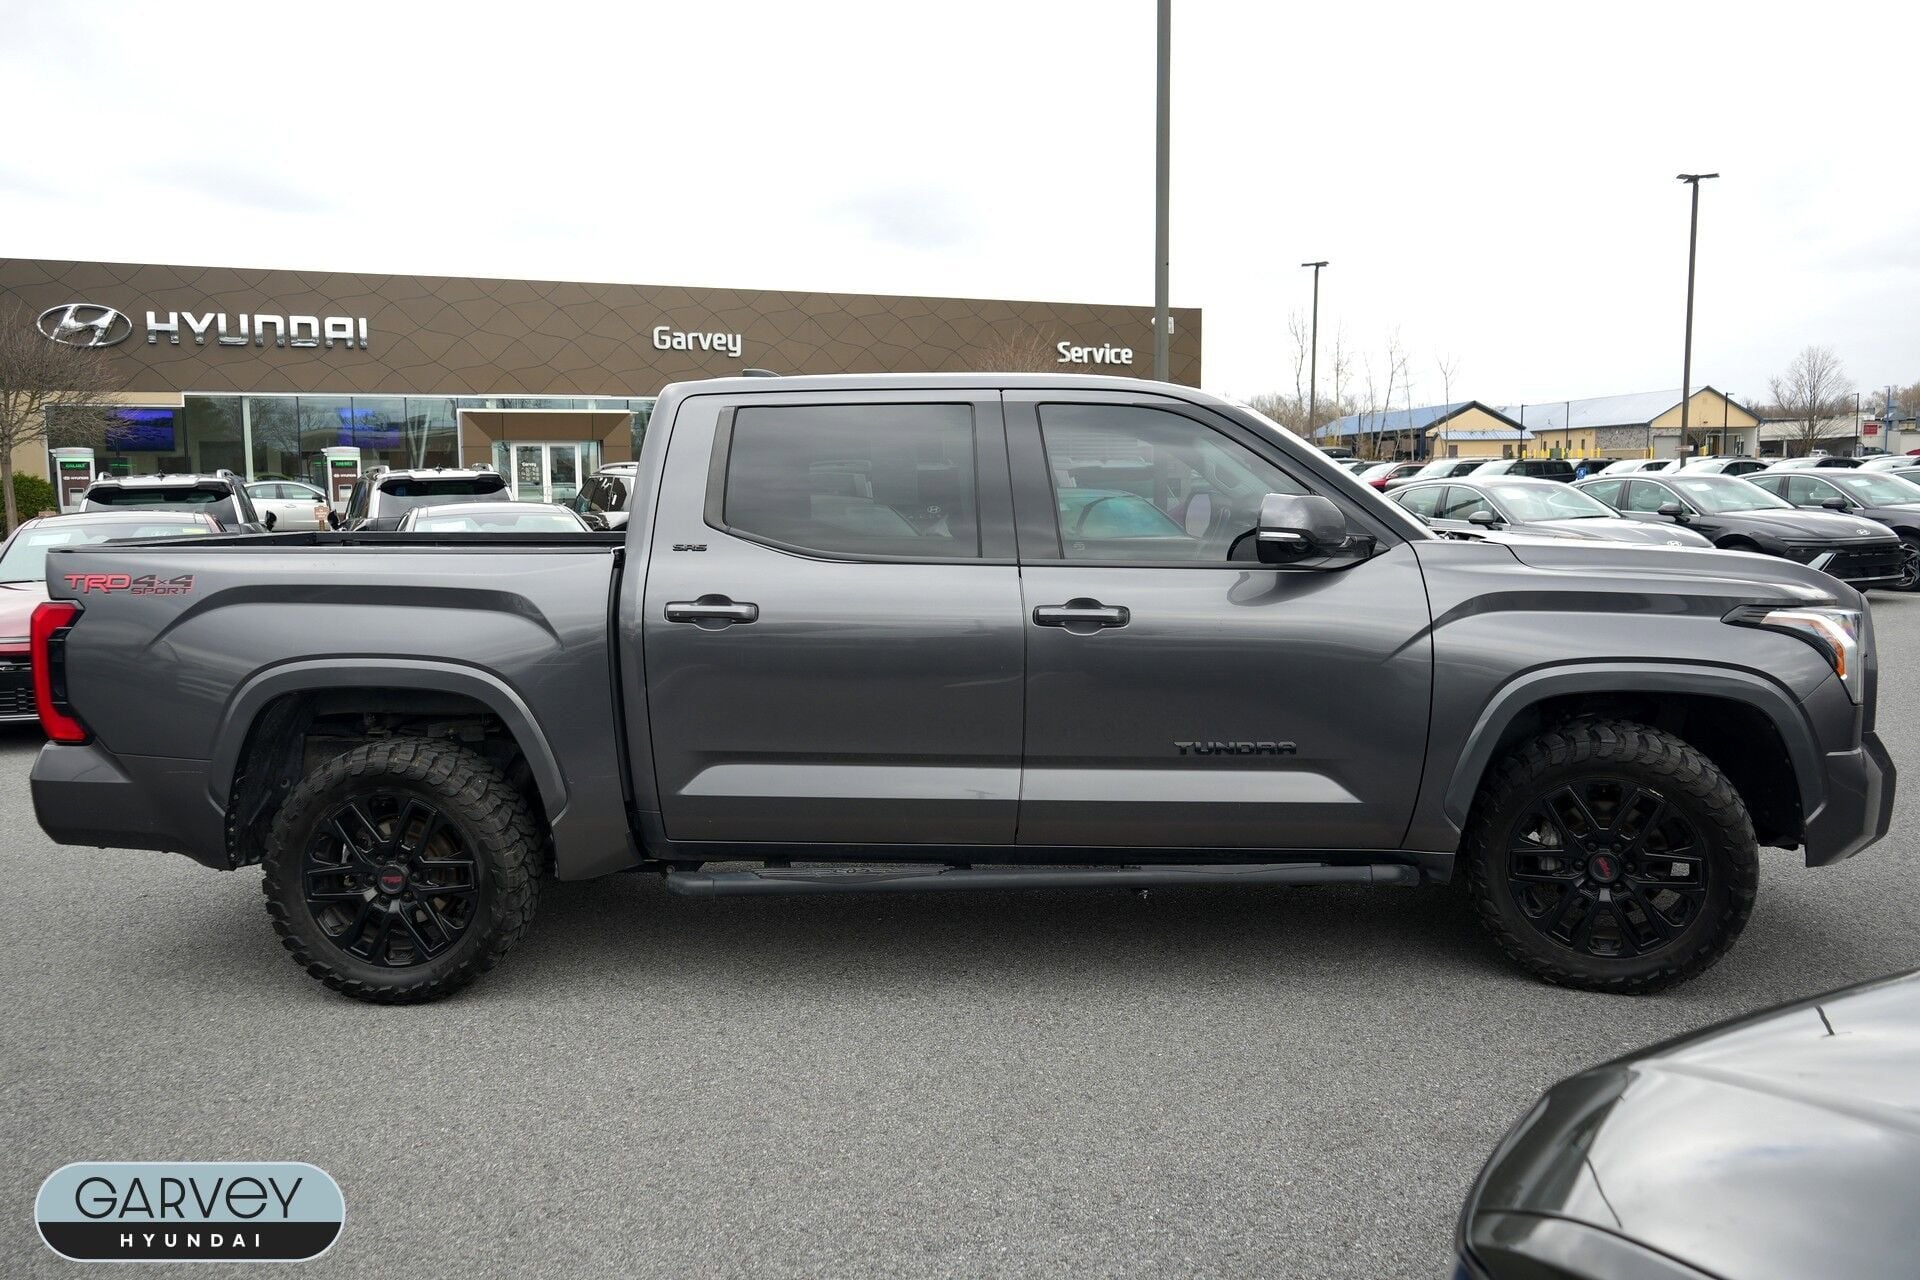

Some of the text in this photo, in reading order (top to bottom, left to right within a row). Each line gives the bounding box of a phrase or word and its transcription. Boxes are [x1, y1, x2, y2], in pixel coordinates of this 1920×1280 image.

[146, 311, 368, 349] HYUNDAI
[653, 326, 742, 357] Garvey
[1057, 341, 1133, 364] Service
[64, 573, 131, 594] TRD
[131, 587, 192, 595] SPORT
[1174, 741, 1297, 755] TUNDRA
